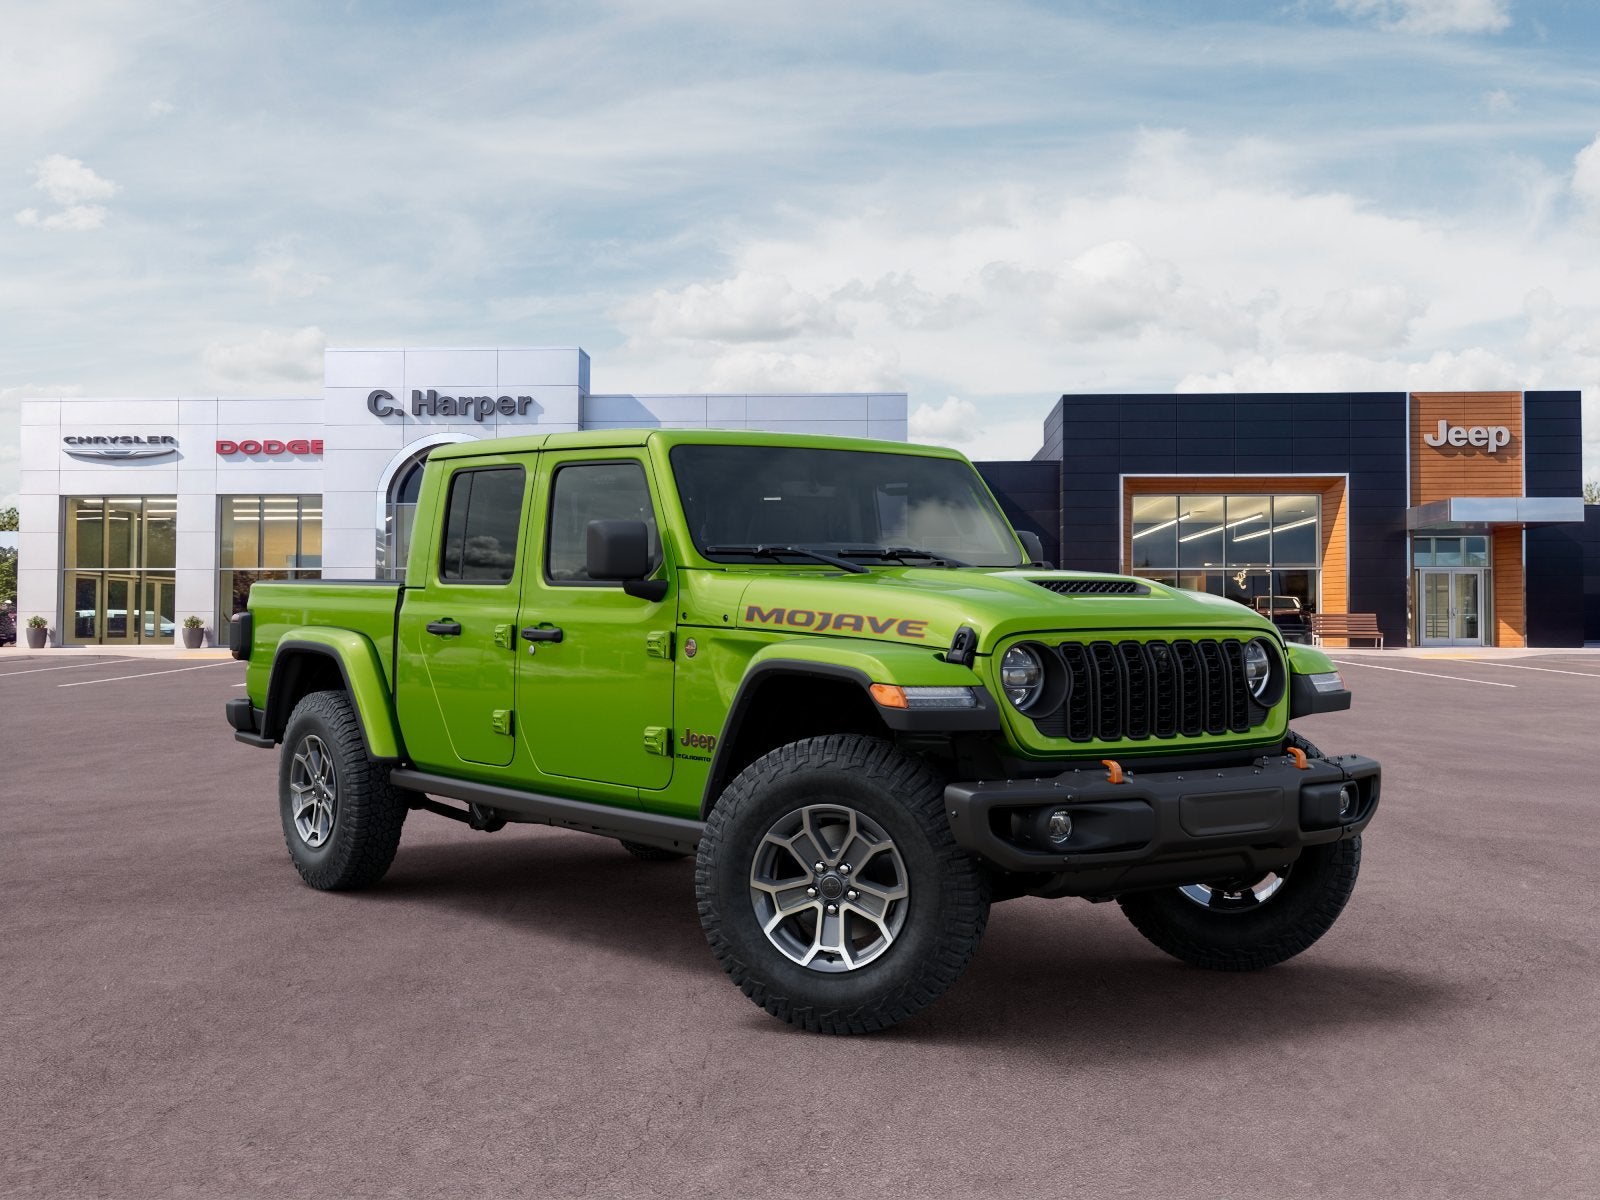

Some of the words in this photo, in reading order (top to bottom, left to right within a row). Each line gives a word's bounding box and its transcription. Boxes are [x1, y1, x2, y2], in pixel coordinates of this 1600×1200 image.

[367, 389, 404, 416] C.
[411, 389, 532, 422] Harper
[63, 435, 176, 445] CHRYSLER
[216, 439, 323, 455] DODGE
[1423, 419, 1510, 452] Jeep
[745, 605, 929, 638] MOJAVE
[680, 728, 716, 753] Jeep
